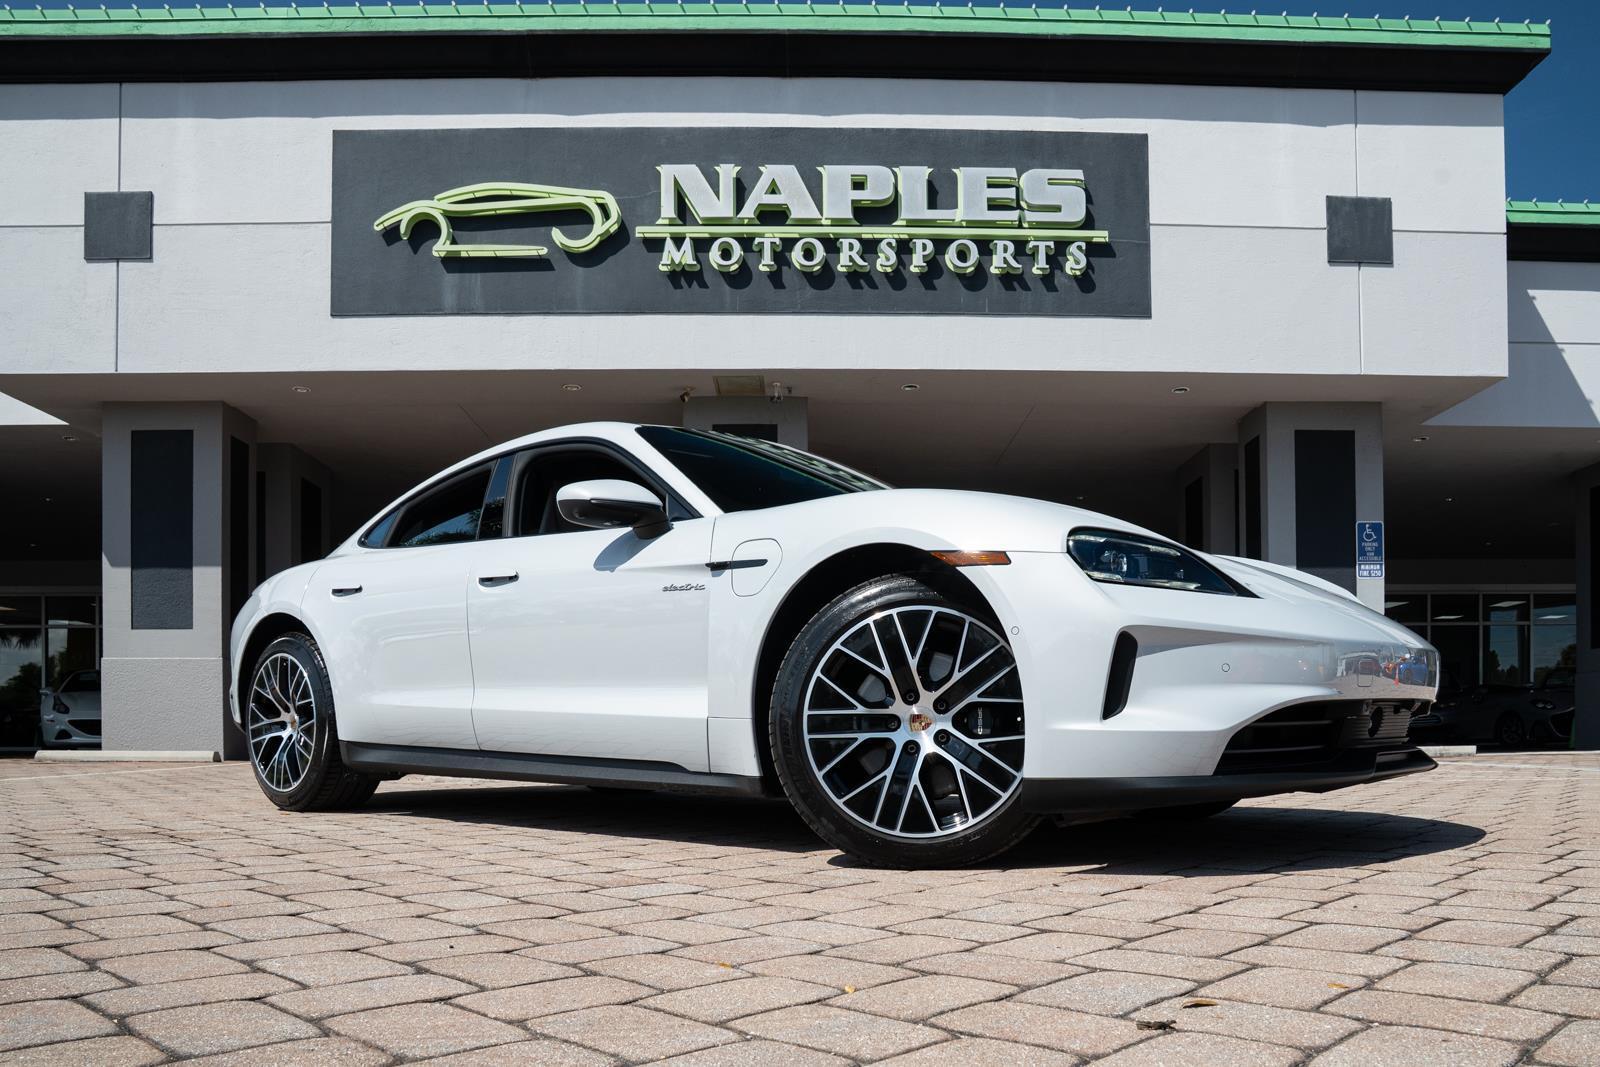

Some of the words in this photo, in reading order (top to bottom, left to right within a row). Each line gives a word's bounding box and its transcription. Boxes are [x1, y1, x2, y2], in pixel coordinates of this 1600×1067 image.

[656, 163, 1086, 228] NAPLES
[658, 237, 1087, 276] MOTORSPORTS
[662, 583, 706, 592] electric
